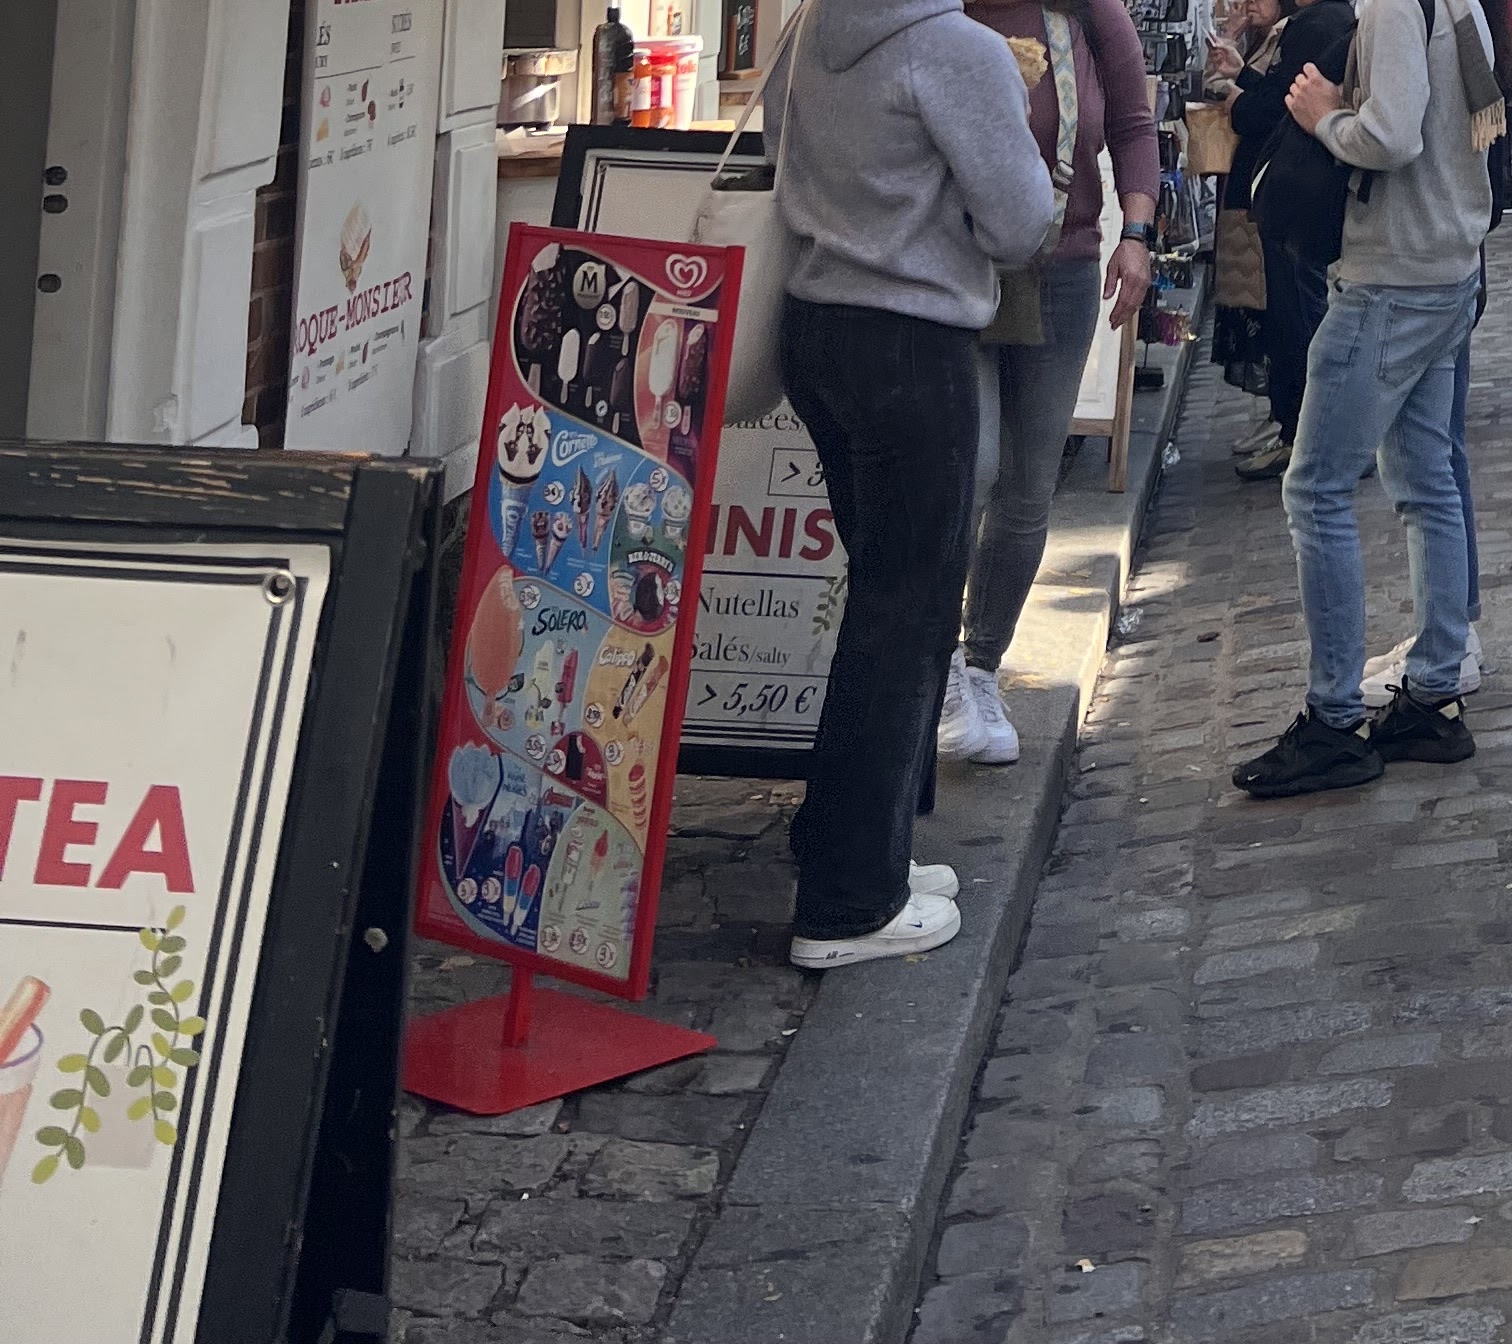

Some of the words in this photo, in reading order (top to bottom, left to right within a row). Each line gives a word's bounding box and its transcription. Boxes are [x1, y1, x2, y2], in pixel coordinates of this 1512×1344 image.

[294, 270, 413, 358] OQUE-MONSIER
[704, 504, 836, 562] INIS
[699, 586, 801, 619] Nutellas
[531, 607, 588, 636] SOLERO
[722, 682, 789, 717] 5,50
[794, 685, 818, 715] €
